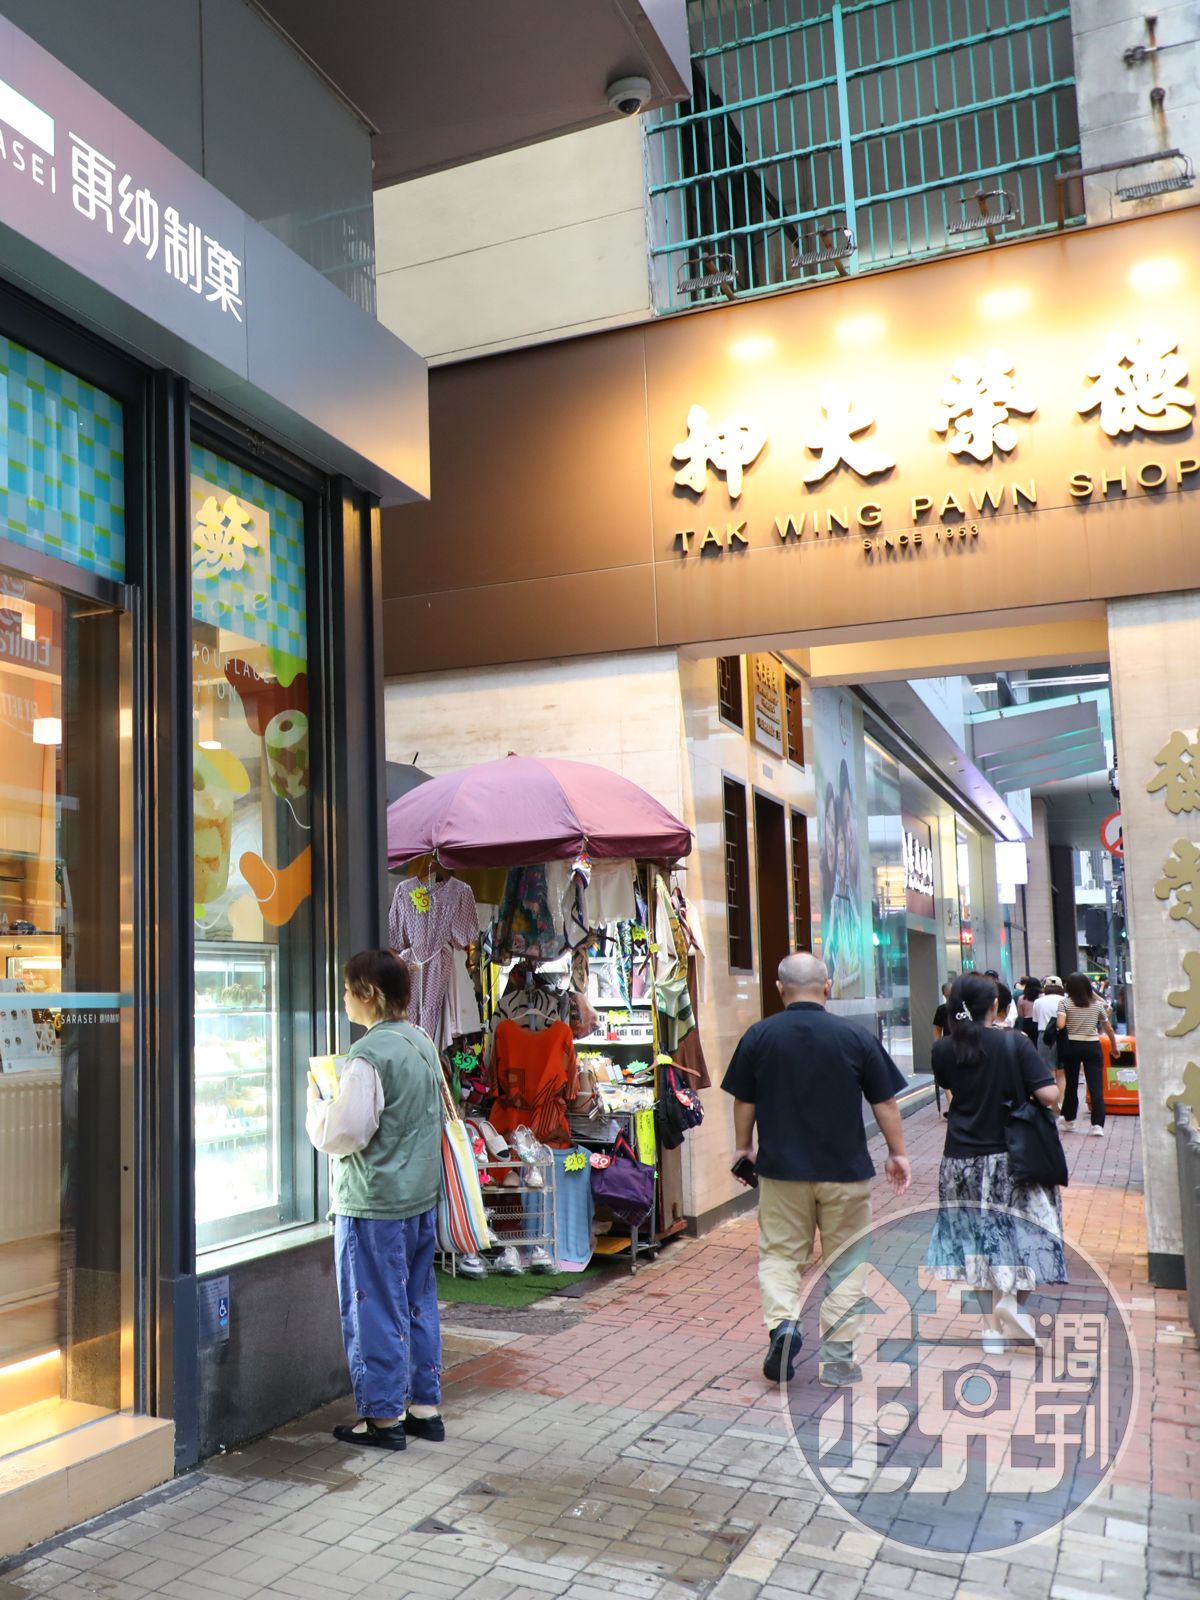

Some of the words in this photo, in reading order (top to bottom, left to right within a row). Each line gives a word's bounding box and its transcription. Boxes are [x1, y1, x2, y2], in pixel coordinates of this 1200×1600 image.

[675, 519, 749, 553] TAK
[774, 501, 883, 538] WING
[911, 479, 1037, 522] PAWN
[1067, 456, 1200, 498] SHOP
[862, 531, 923, 550] SINCE
[935, 523, 979, 542] 1953
[61, 1013, 97, 1025] SARASEI
